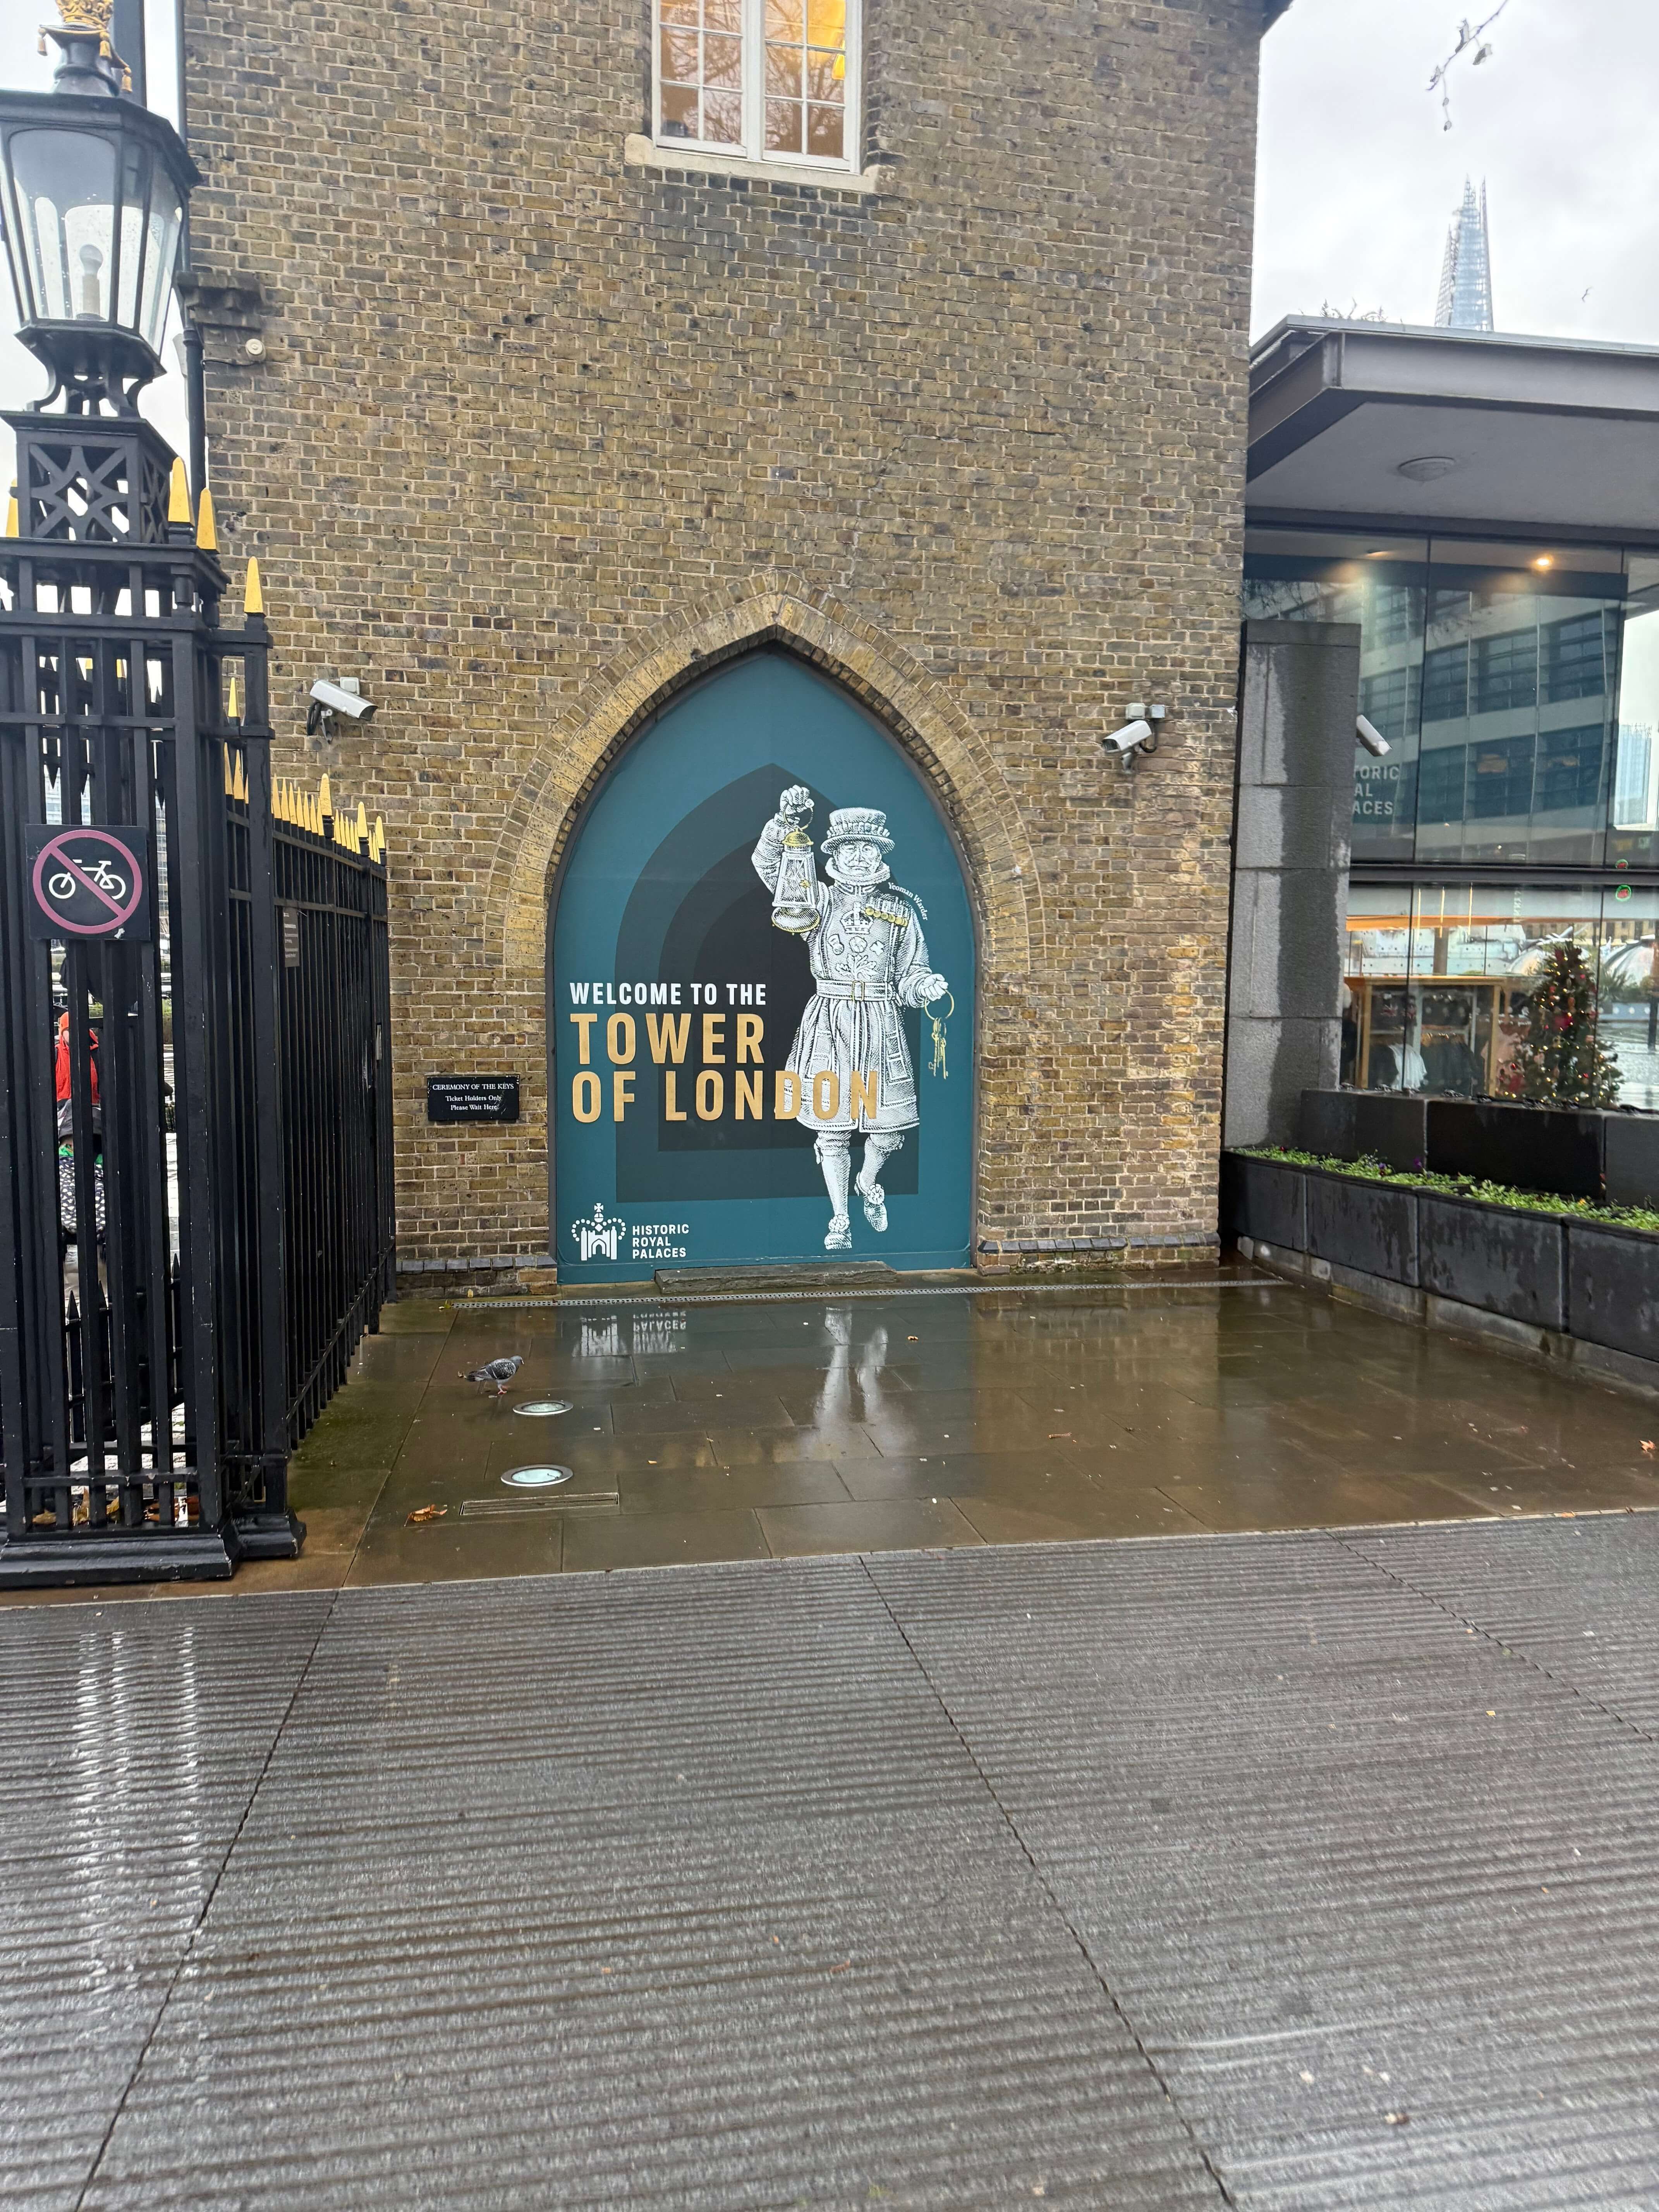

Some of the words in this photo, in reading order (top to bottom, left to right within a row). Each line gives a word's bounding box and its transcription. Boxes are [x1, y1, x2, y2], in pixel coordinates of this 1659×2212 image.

[1352, 800, 1393, 815] ACES
[888, 882, 914, 898] Yeoman
[913, 894, 928, 921] Warder
[570, 982, 681, 1005] WELCOME
[690, 983, 717, 1005] TO
[726, 984, 766, 1005] THE
[570, 1013, 765, 1065] TOWER
[572, 1071, 635, 1123] OF
[665, 1069, 878, 1121] LONDON
[632, 1224, 689, 1236] HISTORIC
[632, 1237, 671, 1247] ROYAL
[632, 1247, 686, 1259] PALACES
